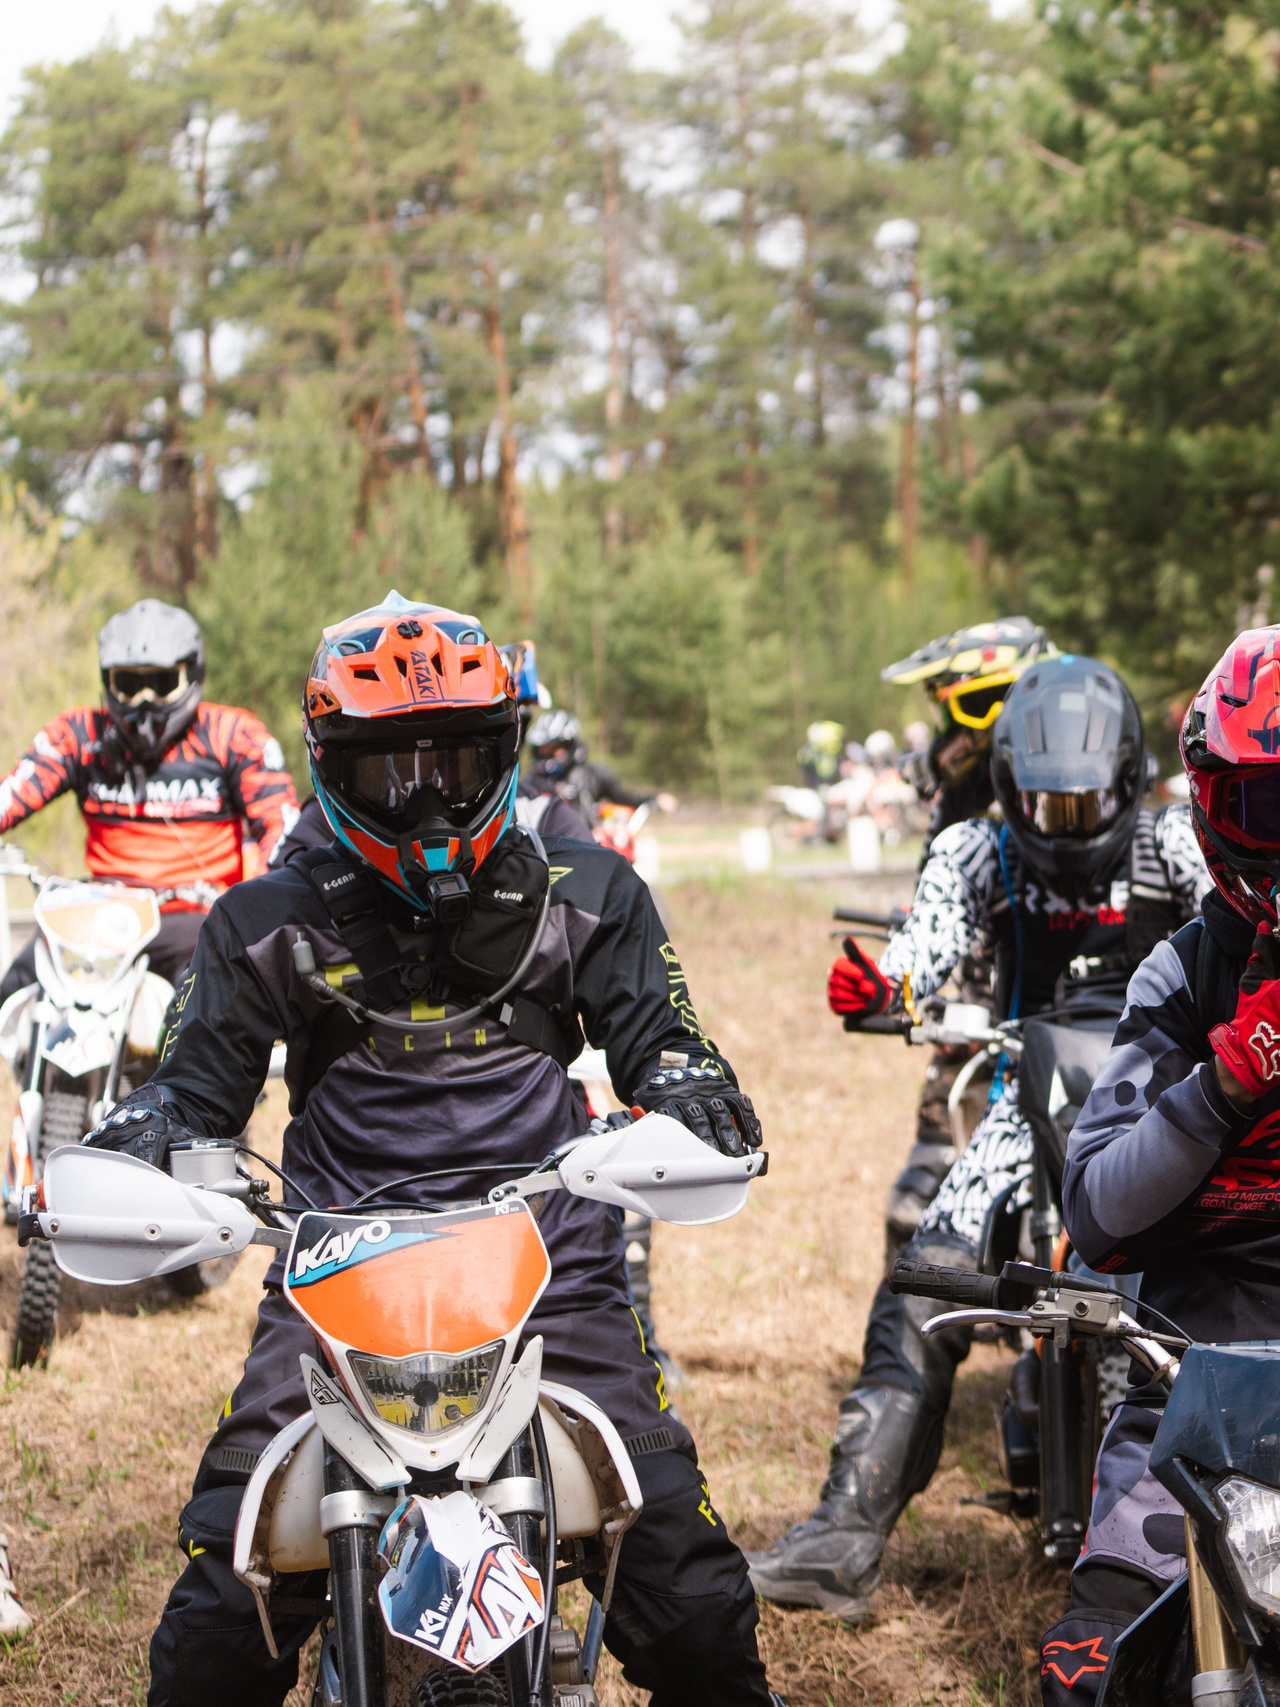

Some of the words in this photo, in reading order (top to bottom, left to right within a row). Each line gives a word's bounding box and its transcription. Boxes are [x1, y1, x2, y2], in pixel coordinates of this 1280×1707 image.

[410, 650, 437, 699] ATAKI
[323, 872, 356, 891] E-GEAR
[493, 889, 523, 903] E-GEAR
[294, 1220, 391, 1280] KAYO
[438, 1594, 453, 1613] MX
